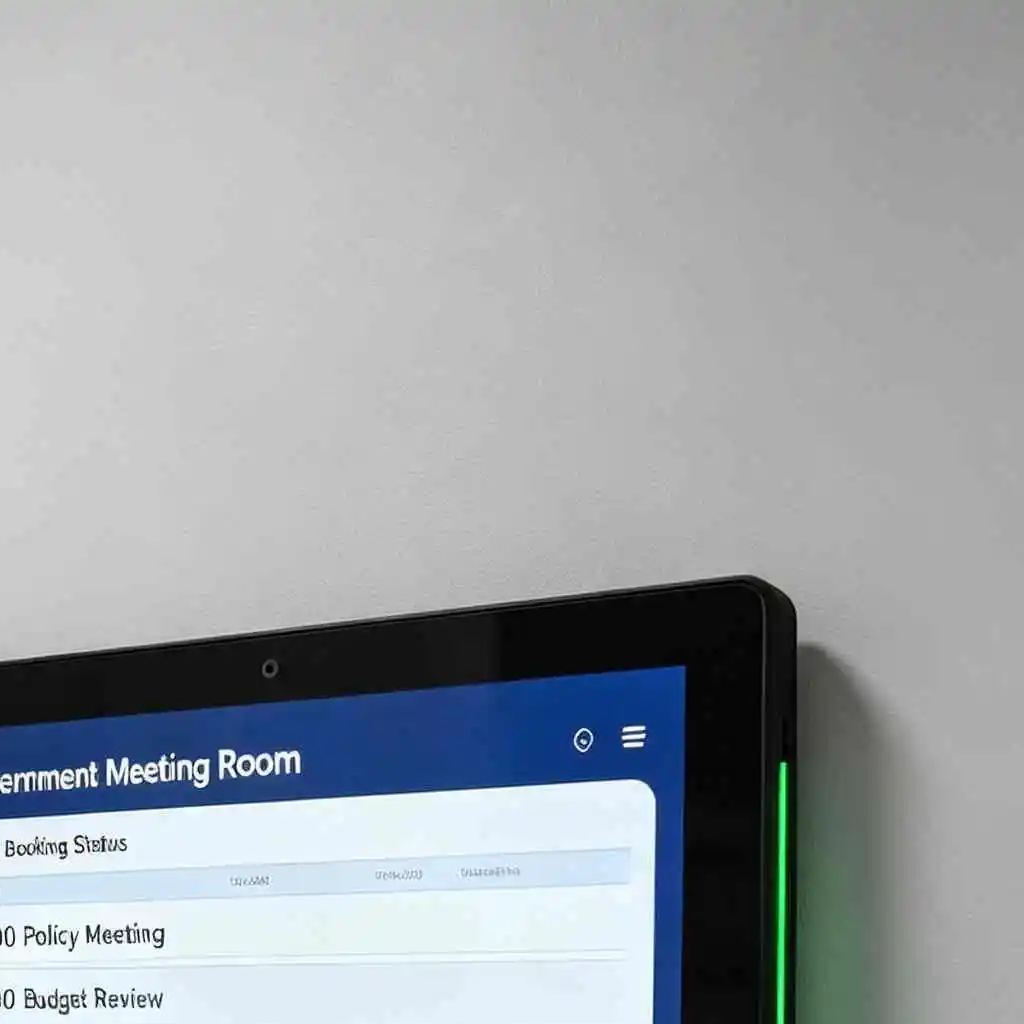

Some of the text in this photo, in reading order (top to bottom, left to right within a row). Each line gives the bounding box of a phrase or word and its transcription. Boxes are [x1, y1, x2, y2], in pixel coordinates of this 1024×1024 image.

[106, 752, 211, 789] Meeting
[217, 748, 301, 781] Room
[4, 835, 69, 861] Booking
[23, 924, 80, 953] Policy
[85, 922, 165, 949] Meeting
[23, 987, 88, 1016] Budget
[93, 986, 164, 1009] Review
